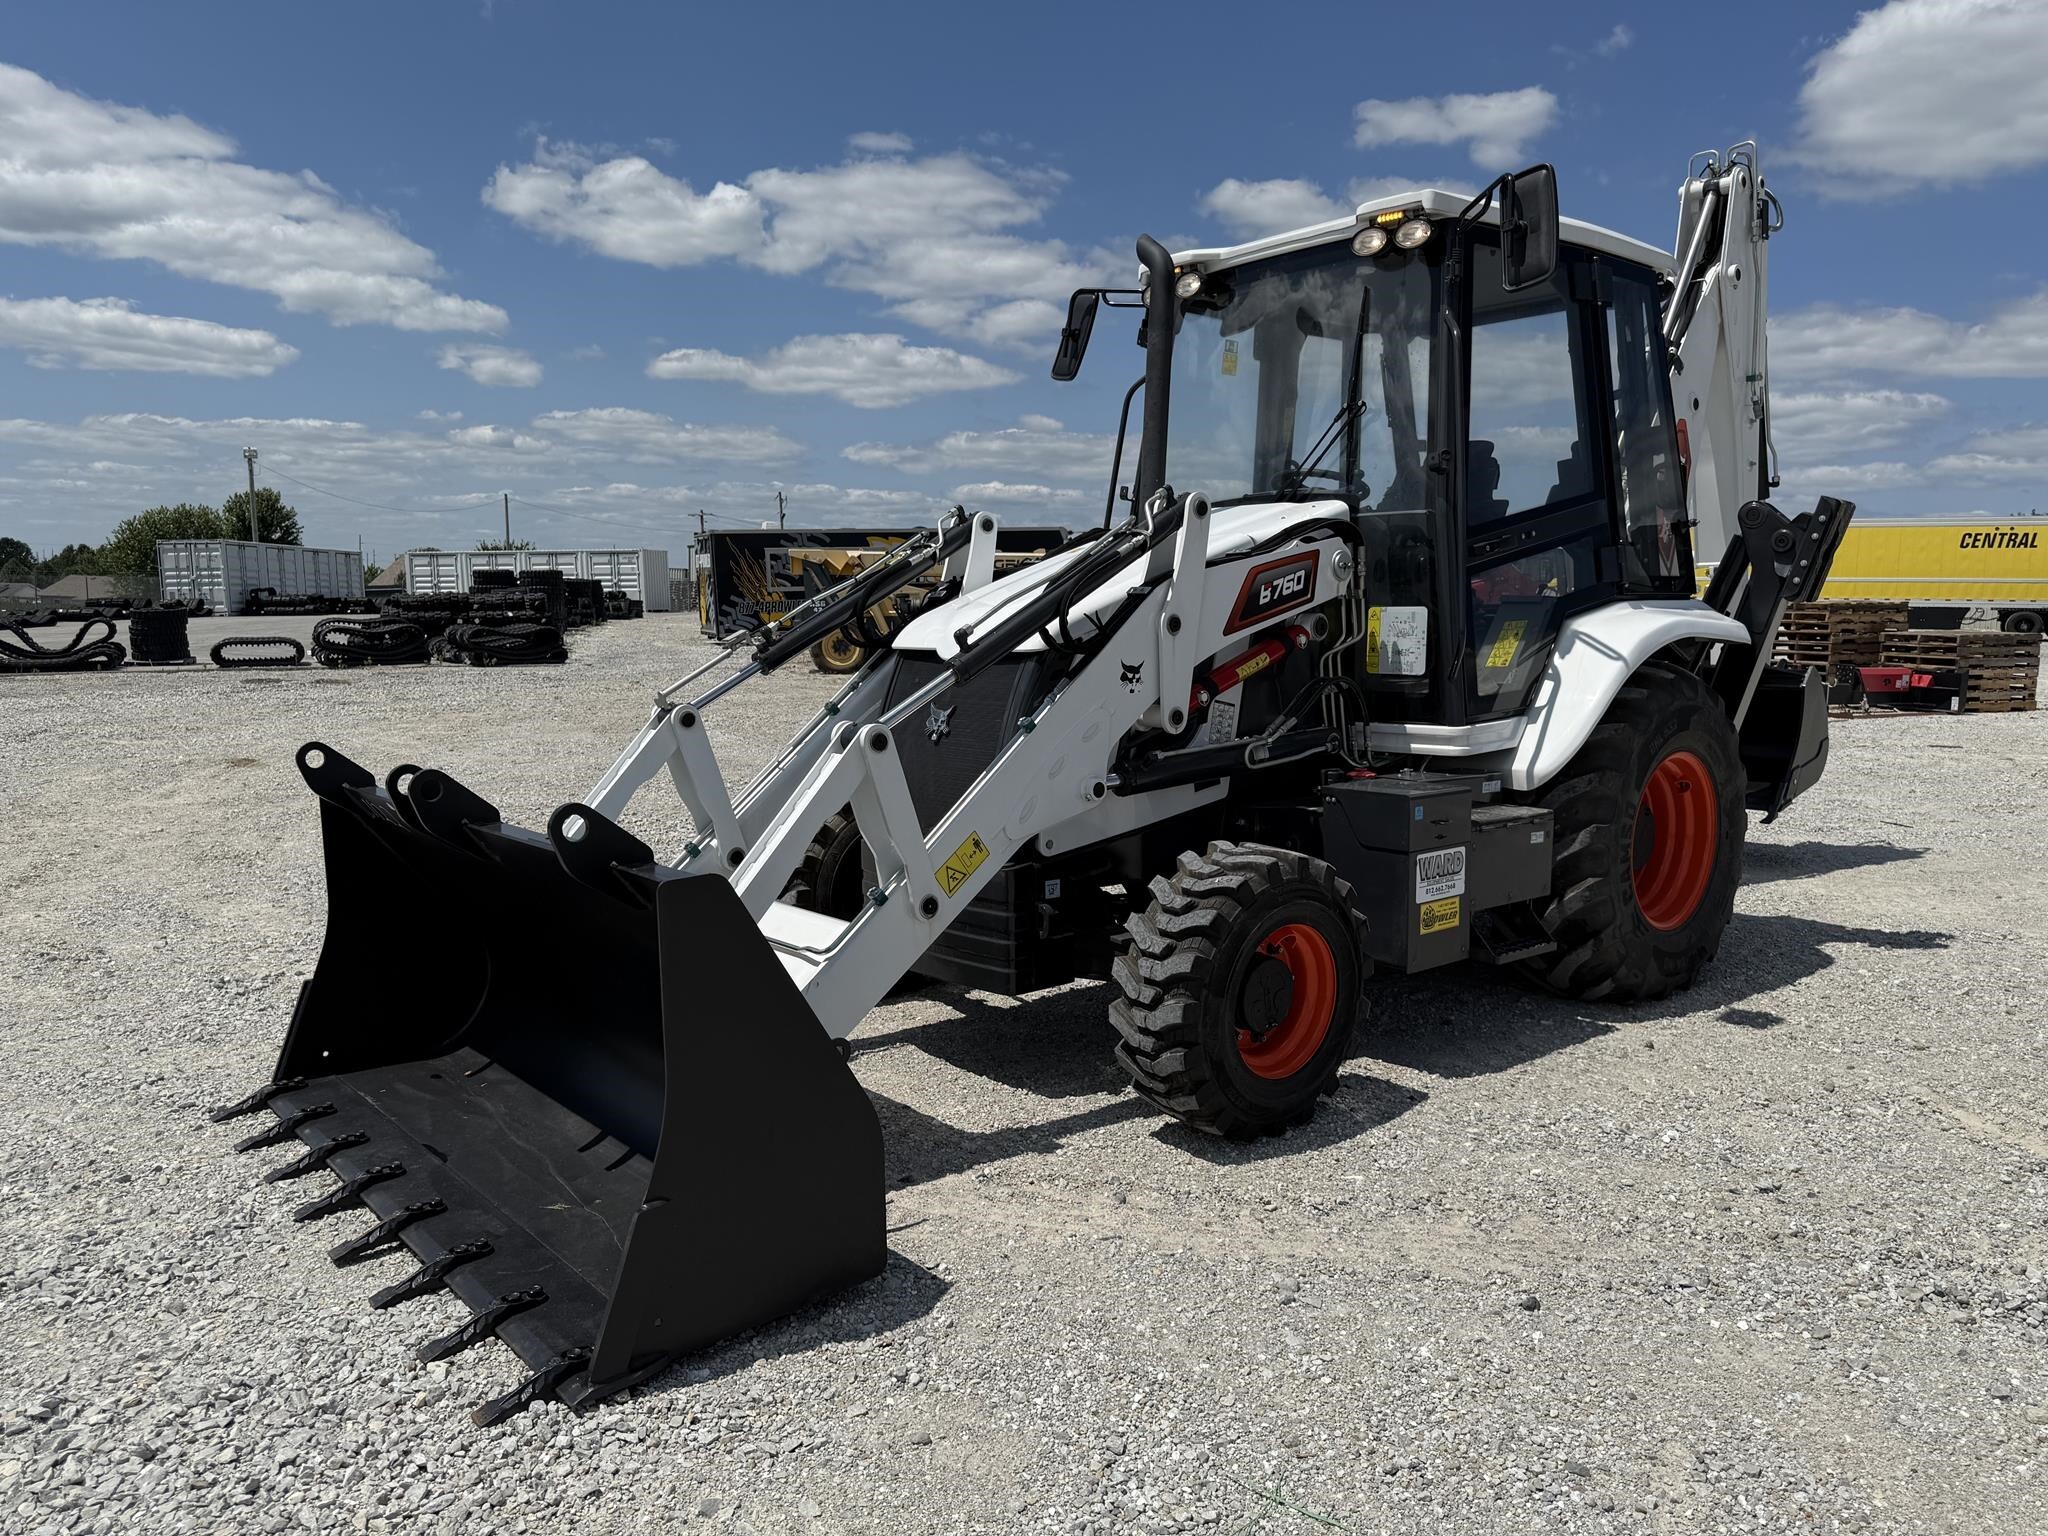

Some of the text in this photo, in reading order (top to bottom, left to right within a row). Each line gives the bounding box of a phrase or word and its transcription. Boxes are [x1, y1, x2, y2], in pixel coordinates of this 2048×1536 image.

[1959, 532, 2038, 549] CENTRAL
[1259, 569, 1305, 606] B760
[1418, 850, 1464, 882] WARD
